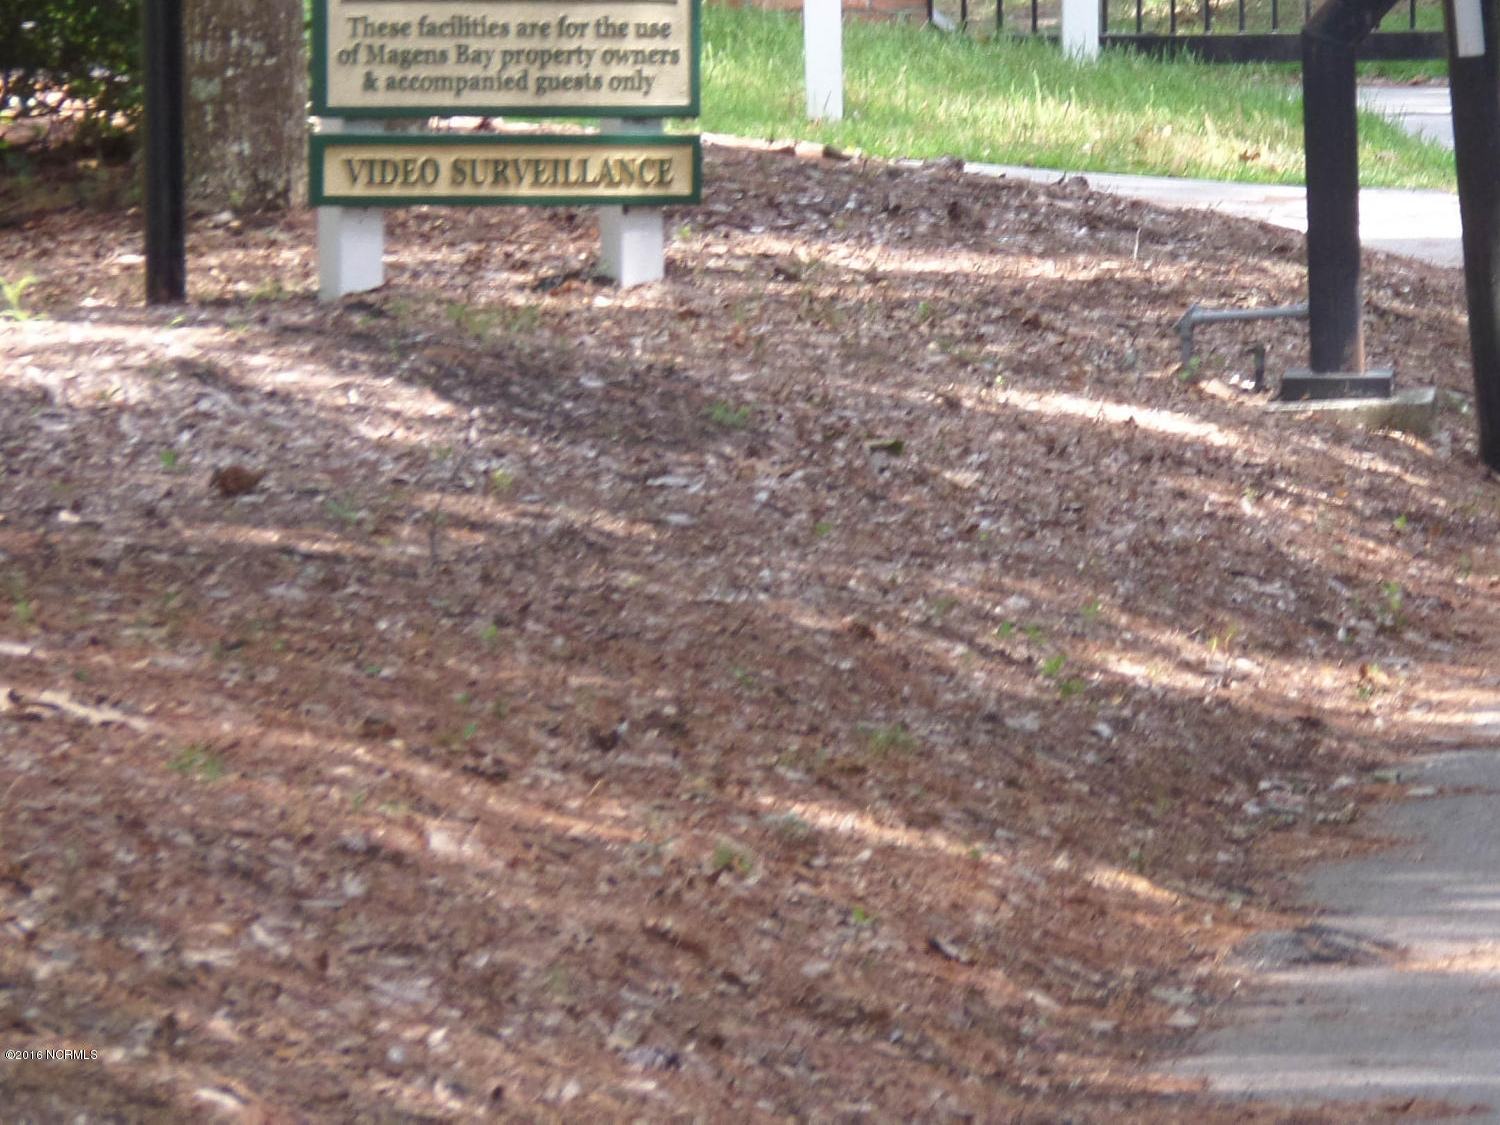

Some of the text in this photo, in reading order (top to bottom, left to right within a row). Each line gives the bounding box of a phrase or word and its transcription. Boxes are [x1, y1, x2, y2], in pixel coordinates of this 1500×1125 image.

[348, 14, 671, 39] These facilities are for the use
[338, 42, 680, 71] of Magens Bay property owners
[362, 70, 656, 96] & accompanied guests only
[343, 157, 674, 187] VIDEO SURVEILLANCE
